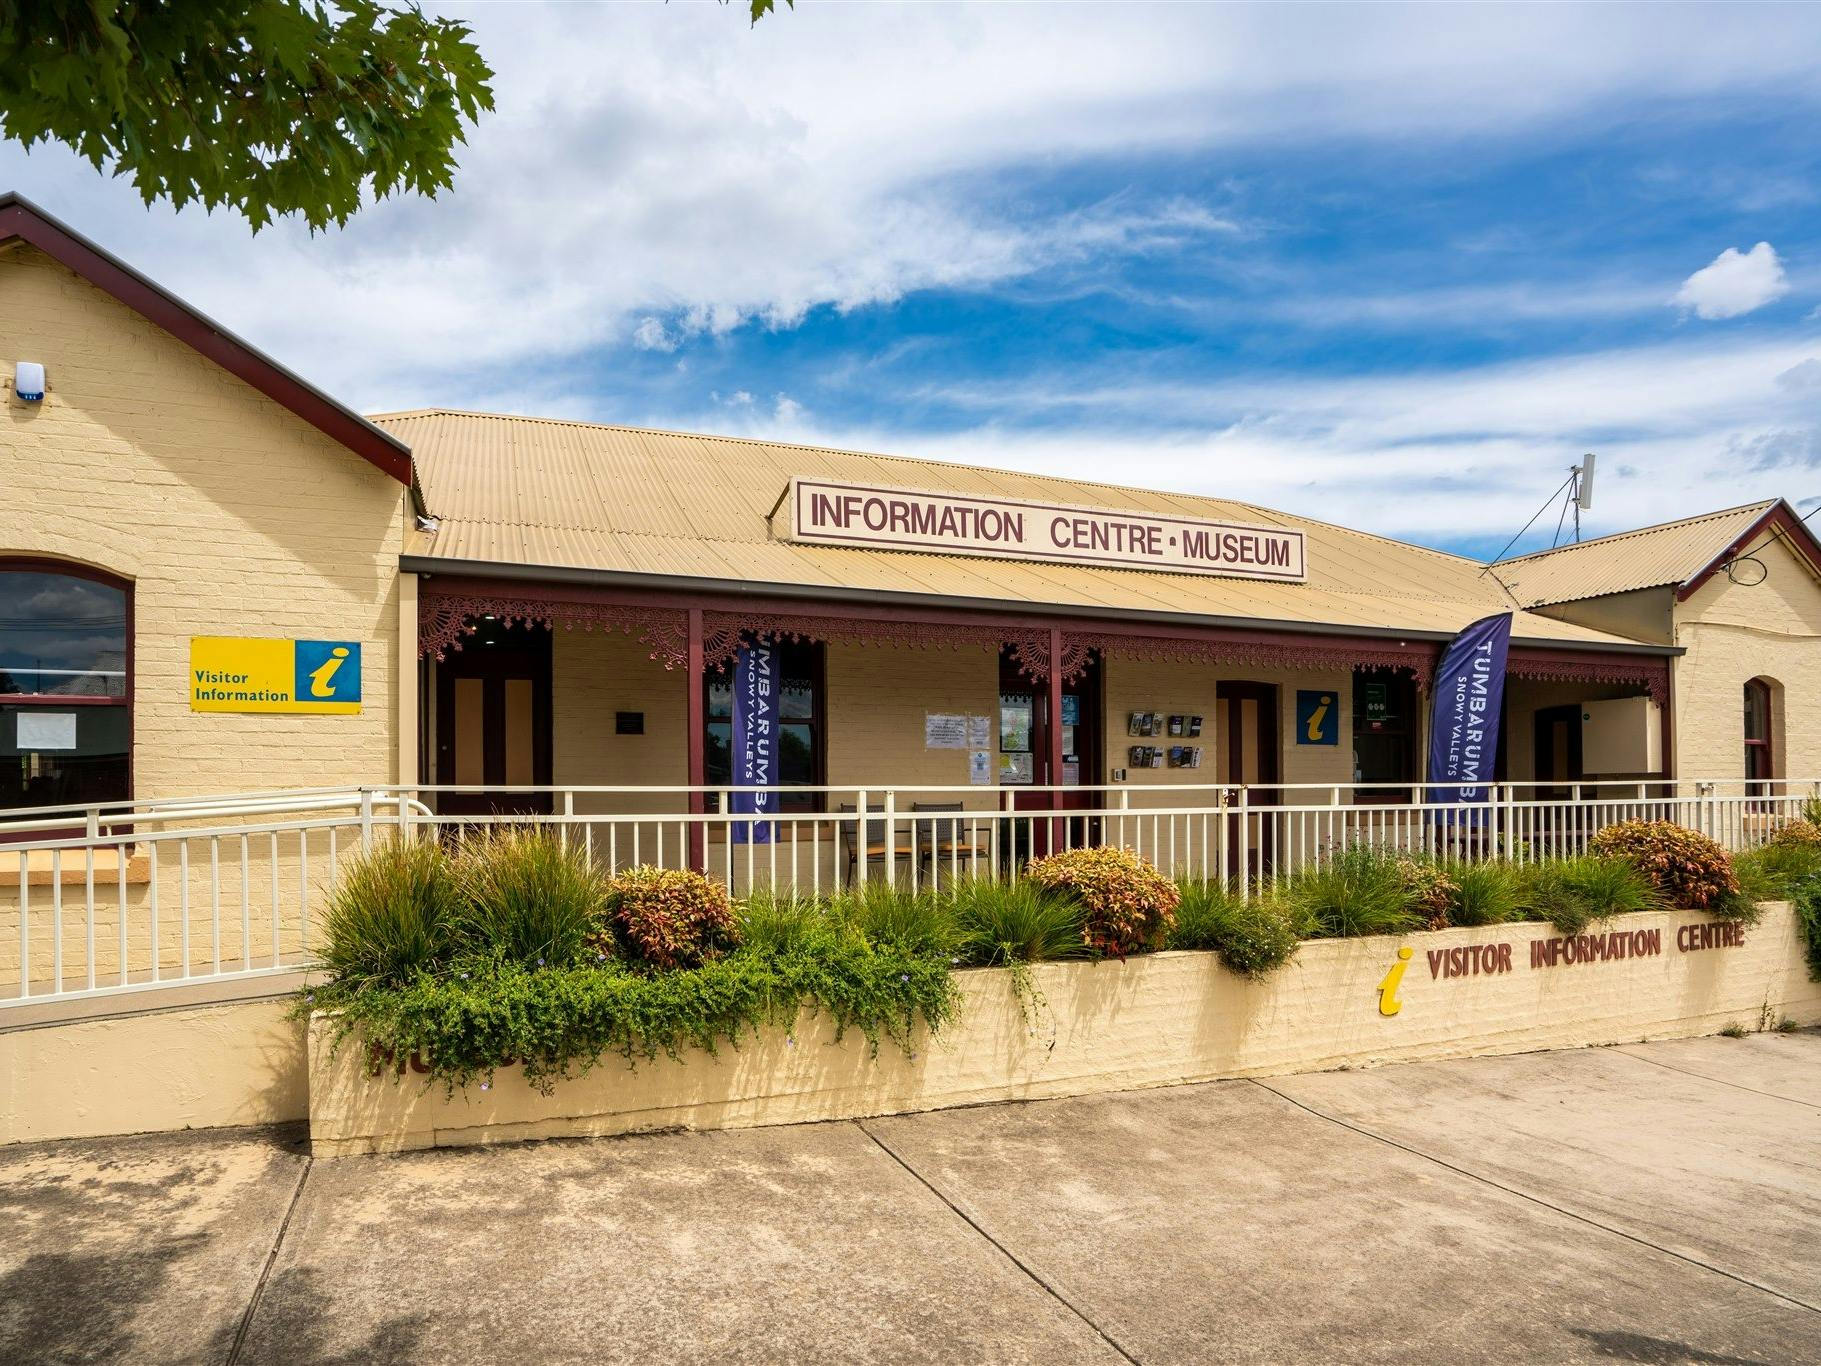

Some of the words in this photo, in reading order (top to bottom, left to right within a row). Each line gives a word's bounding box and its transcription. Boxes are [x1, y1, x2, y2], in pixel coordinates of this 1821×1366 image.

[811, 493, 1024, 543] INFORMATION
[1050, 516, 1163, 556] CENTRE
[1183, 529, 1290, 567] MUSEUM
[195, 671, 248, 684] Visitor
[196, 688, 288, 702] Information
[748, 650, 756, 708] SNOWY
[1453, 677, 1467, 721] SNOWY
[745, 712, 754, 778] VALLEYS
[1447, 725, 1462, 777] VALLEYS
[1427, 942, 1512, 980] VISITOR
[1530, 929, 1661, 969] INFORMATION
[1677, 921, 1745, 953] CENTRE
